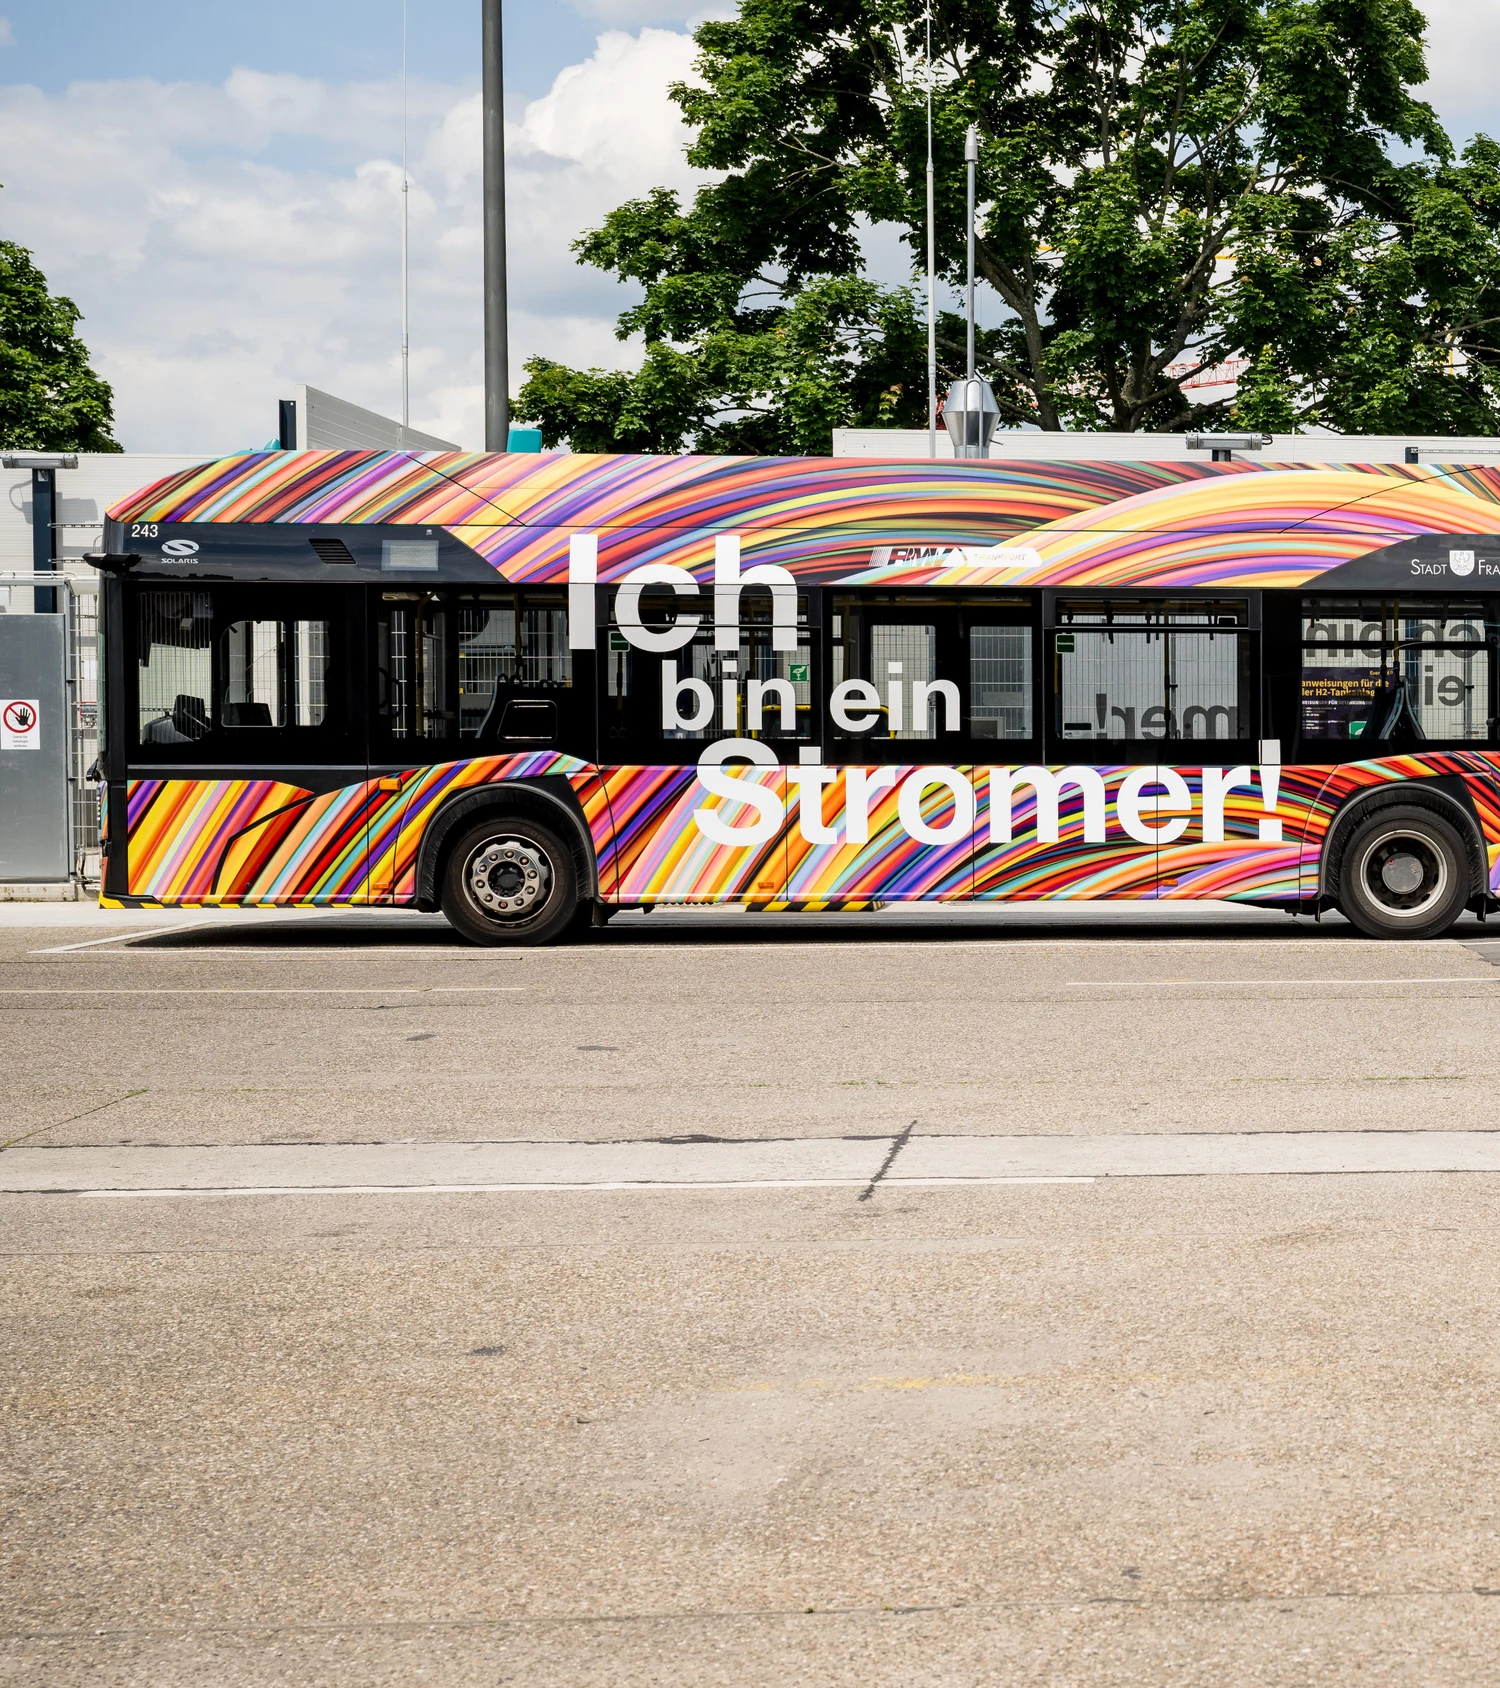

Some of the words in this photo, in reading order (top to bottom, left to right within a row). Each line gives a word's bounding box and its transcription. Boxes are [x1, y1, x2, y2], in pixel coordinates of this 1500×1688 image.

[131, 524, 159, 538] 243
[568, 534, 798, 653] Ich
[661, 660, 797, 732] bin
[830, 662, 961, 732] ein
[1360, 679, 1374, 688] für
[1375, 679, 1390, 688] de
[693, 738, 1283, 847] Stromer!
